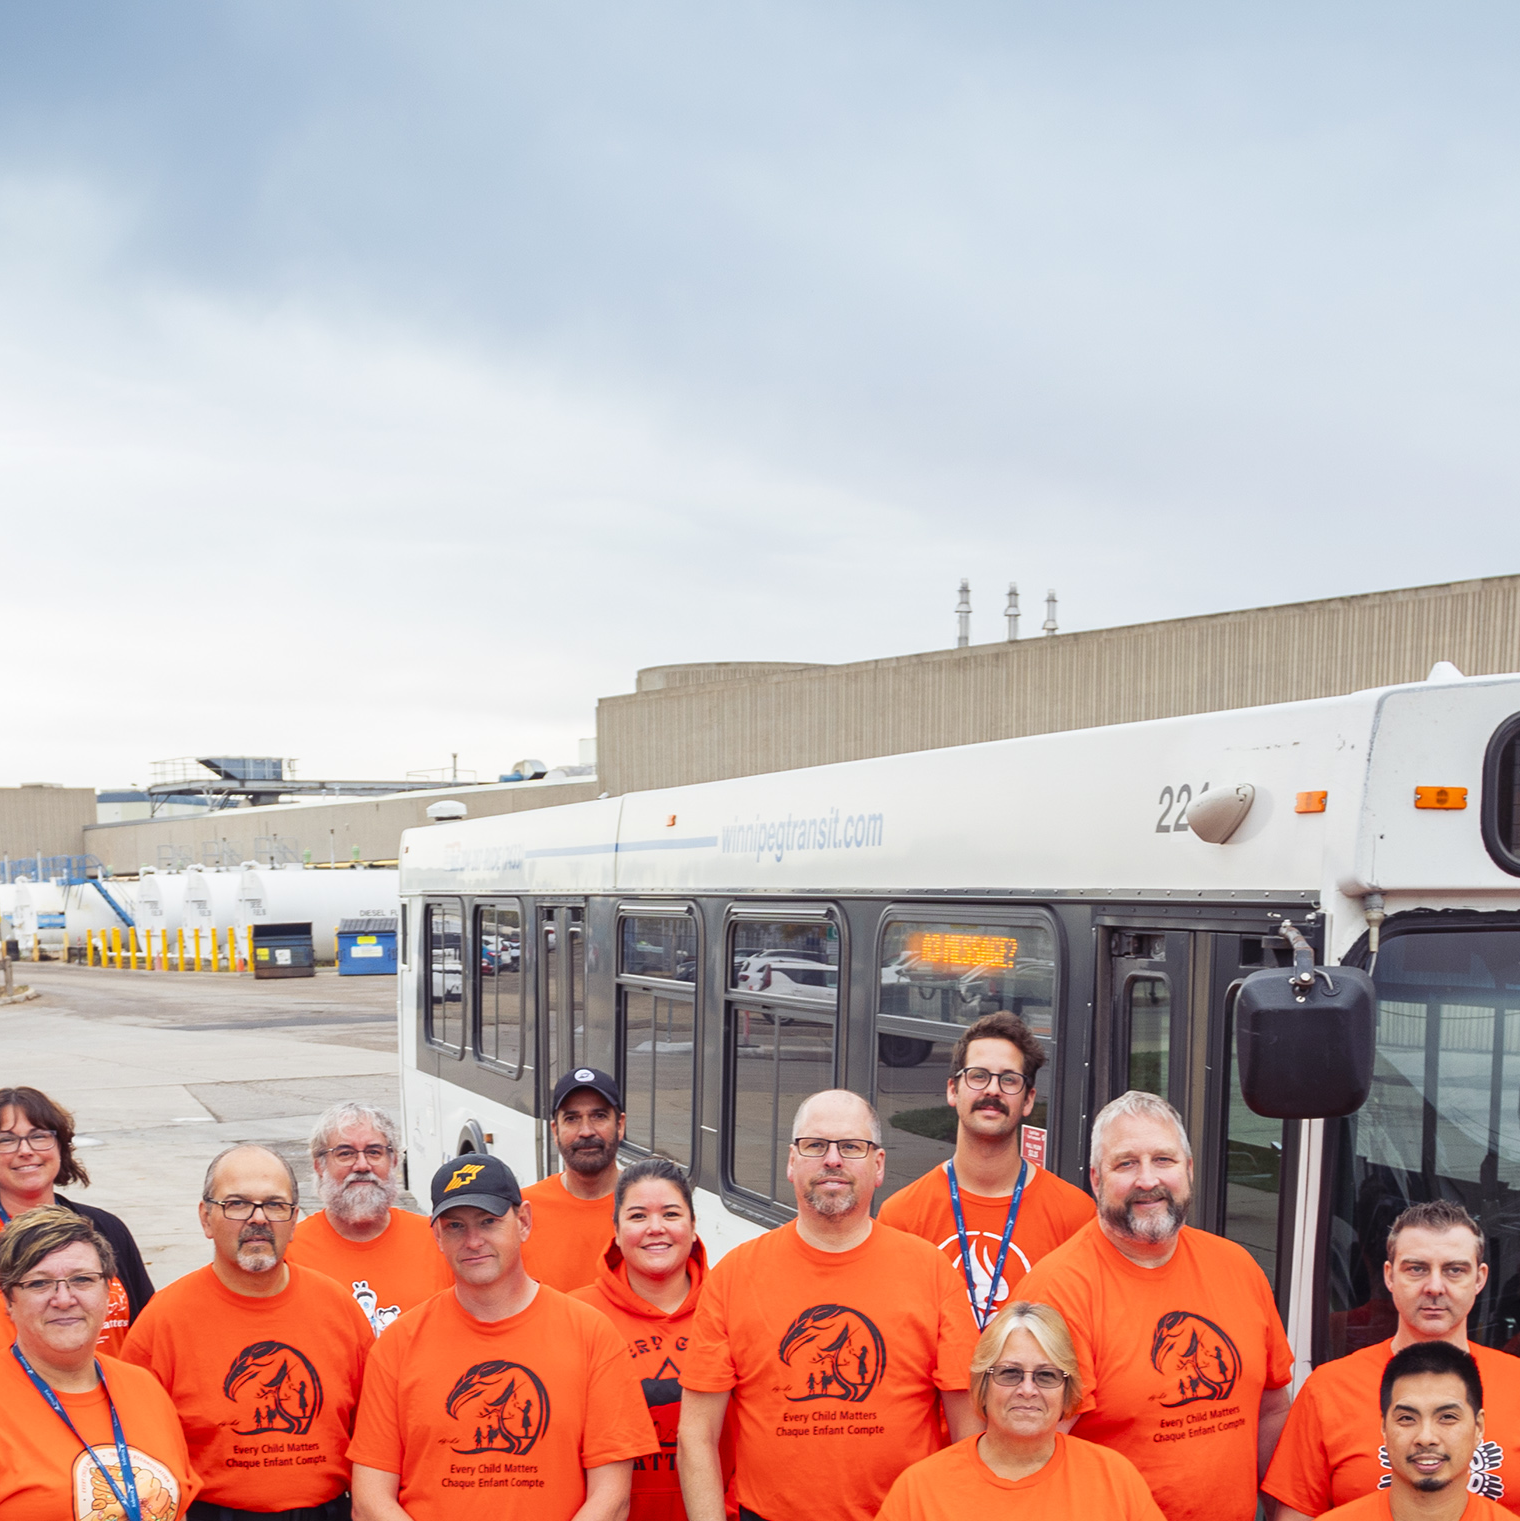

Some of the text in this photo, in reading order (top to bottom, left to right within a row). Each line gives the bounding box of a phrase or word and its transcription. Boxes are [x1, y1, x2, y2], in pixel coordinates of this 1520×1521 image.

[1155, 781, 1210, 833] 22
[722, 806, 884, 863] winnipegtransit.com
[783, 1411, 877, 1424] Every Child Matters
[1160, 1406, 1240, 1428] Every Child Matters
[776, 1425, 885, 1438] Chaque Enfant Compte
[1153, 1418, 1246, 1443] Chaque Enfant Compte
[233, 1442, 319, 1456] Every Child Matters
[226, 1455, 327, 1470] Chaque Enfant Compte
[450, 1463, 538, 1476] Every Child Matters
[441, 1477, 545, 1490] Chaque Enfant Compte
